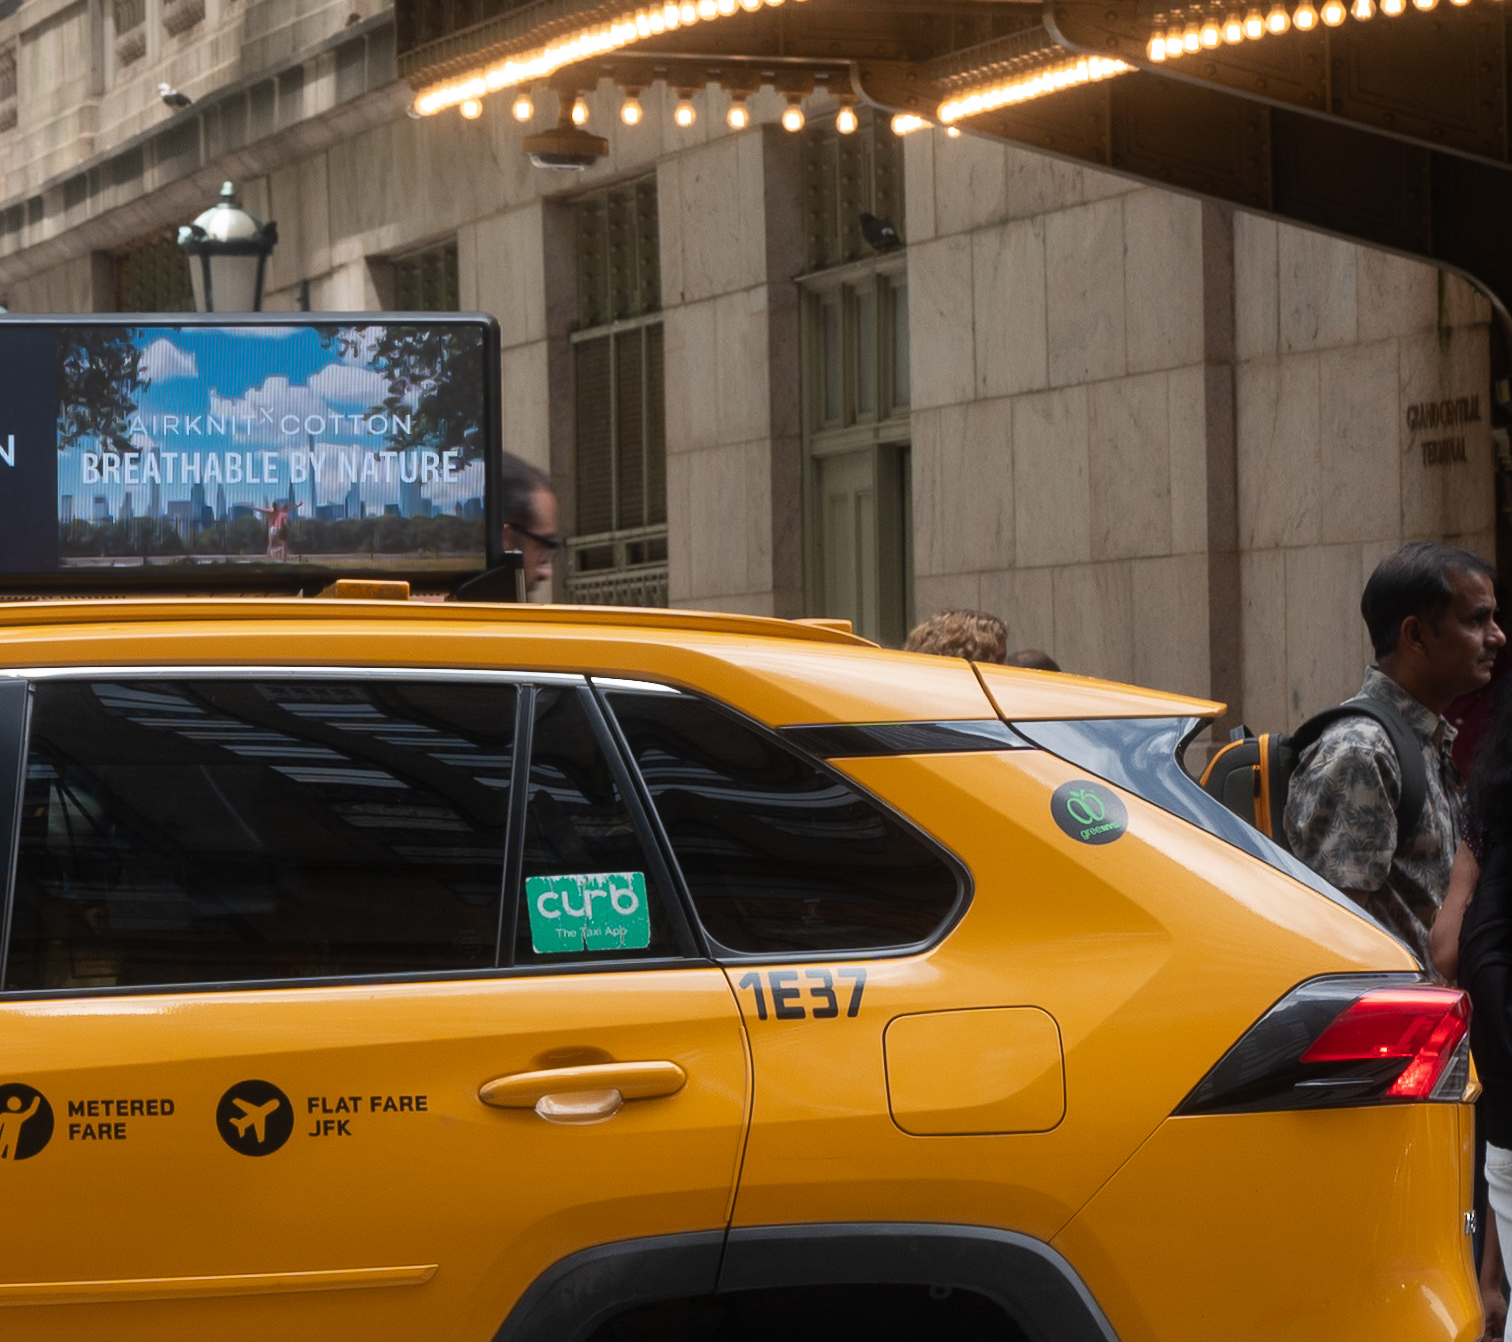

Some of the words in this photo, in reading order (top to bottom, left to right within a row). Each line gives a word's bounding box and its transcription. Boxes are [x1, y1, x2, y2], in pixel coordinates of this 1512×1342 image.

[128, 414, 257, 436] AIRKNIT
[280, 413, 412, 436] COTTON
[82, 451, 279, 485] BREATHABLE
[291, 451, 324, 483] BY
[339, 450, 459, 484] NATURE
[536, 883, 640, 920] curb
[555, 927, 577, 938] The
[581, 926, 603, 937] Taxi
[604, 925, 628, 938] App
[739, 967, 867, 1021] 1E37
[68, 1099, 175, 1118] METERED
[308, 1097, 362, 1115] FLAT
[370, 1095, 429, 1113] FARE
[69, 1123, 127, 1141] FARE
[308, 1120, 353, 1138] JFK
